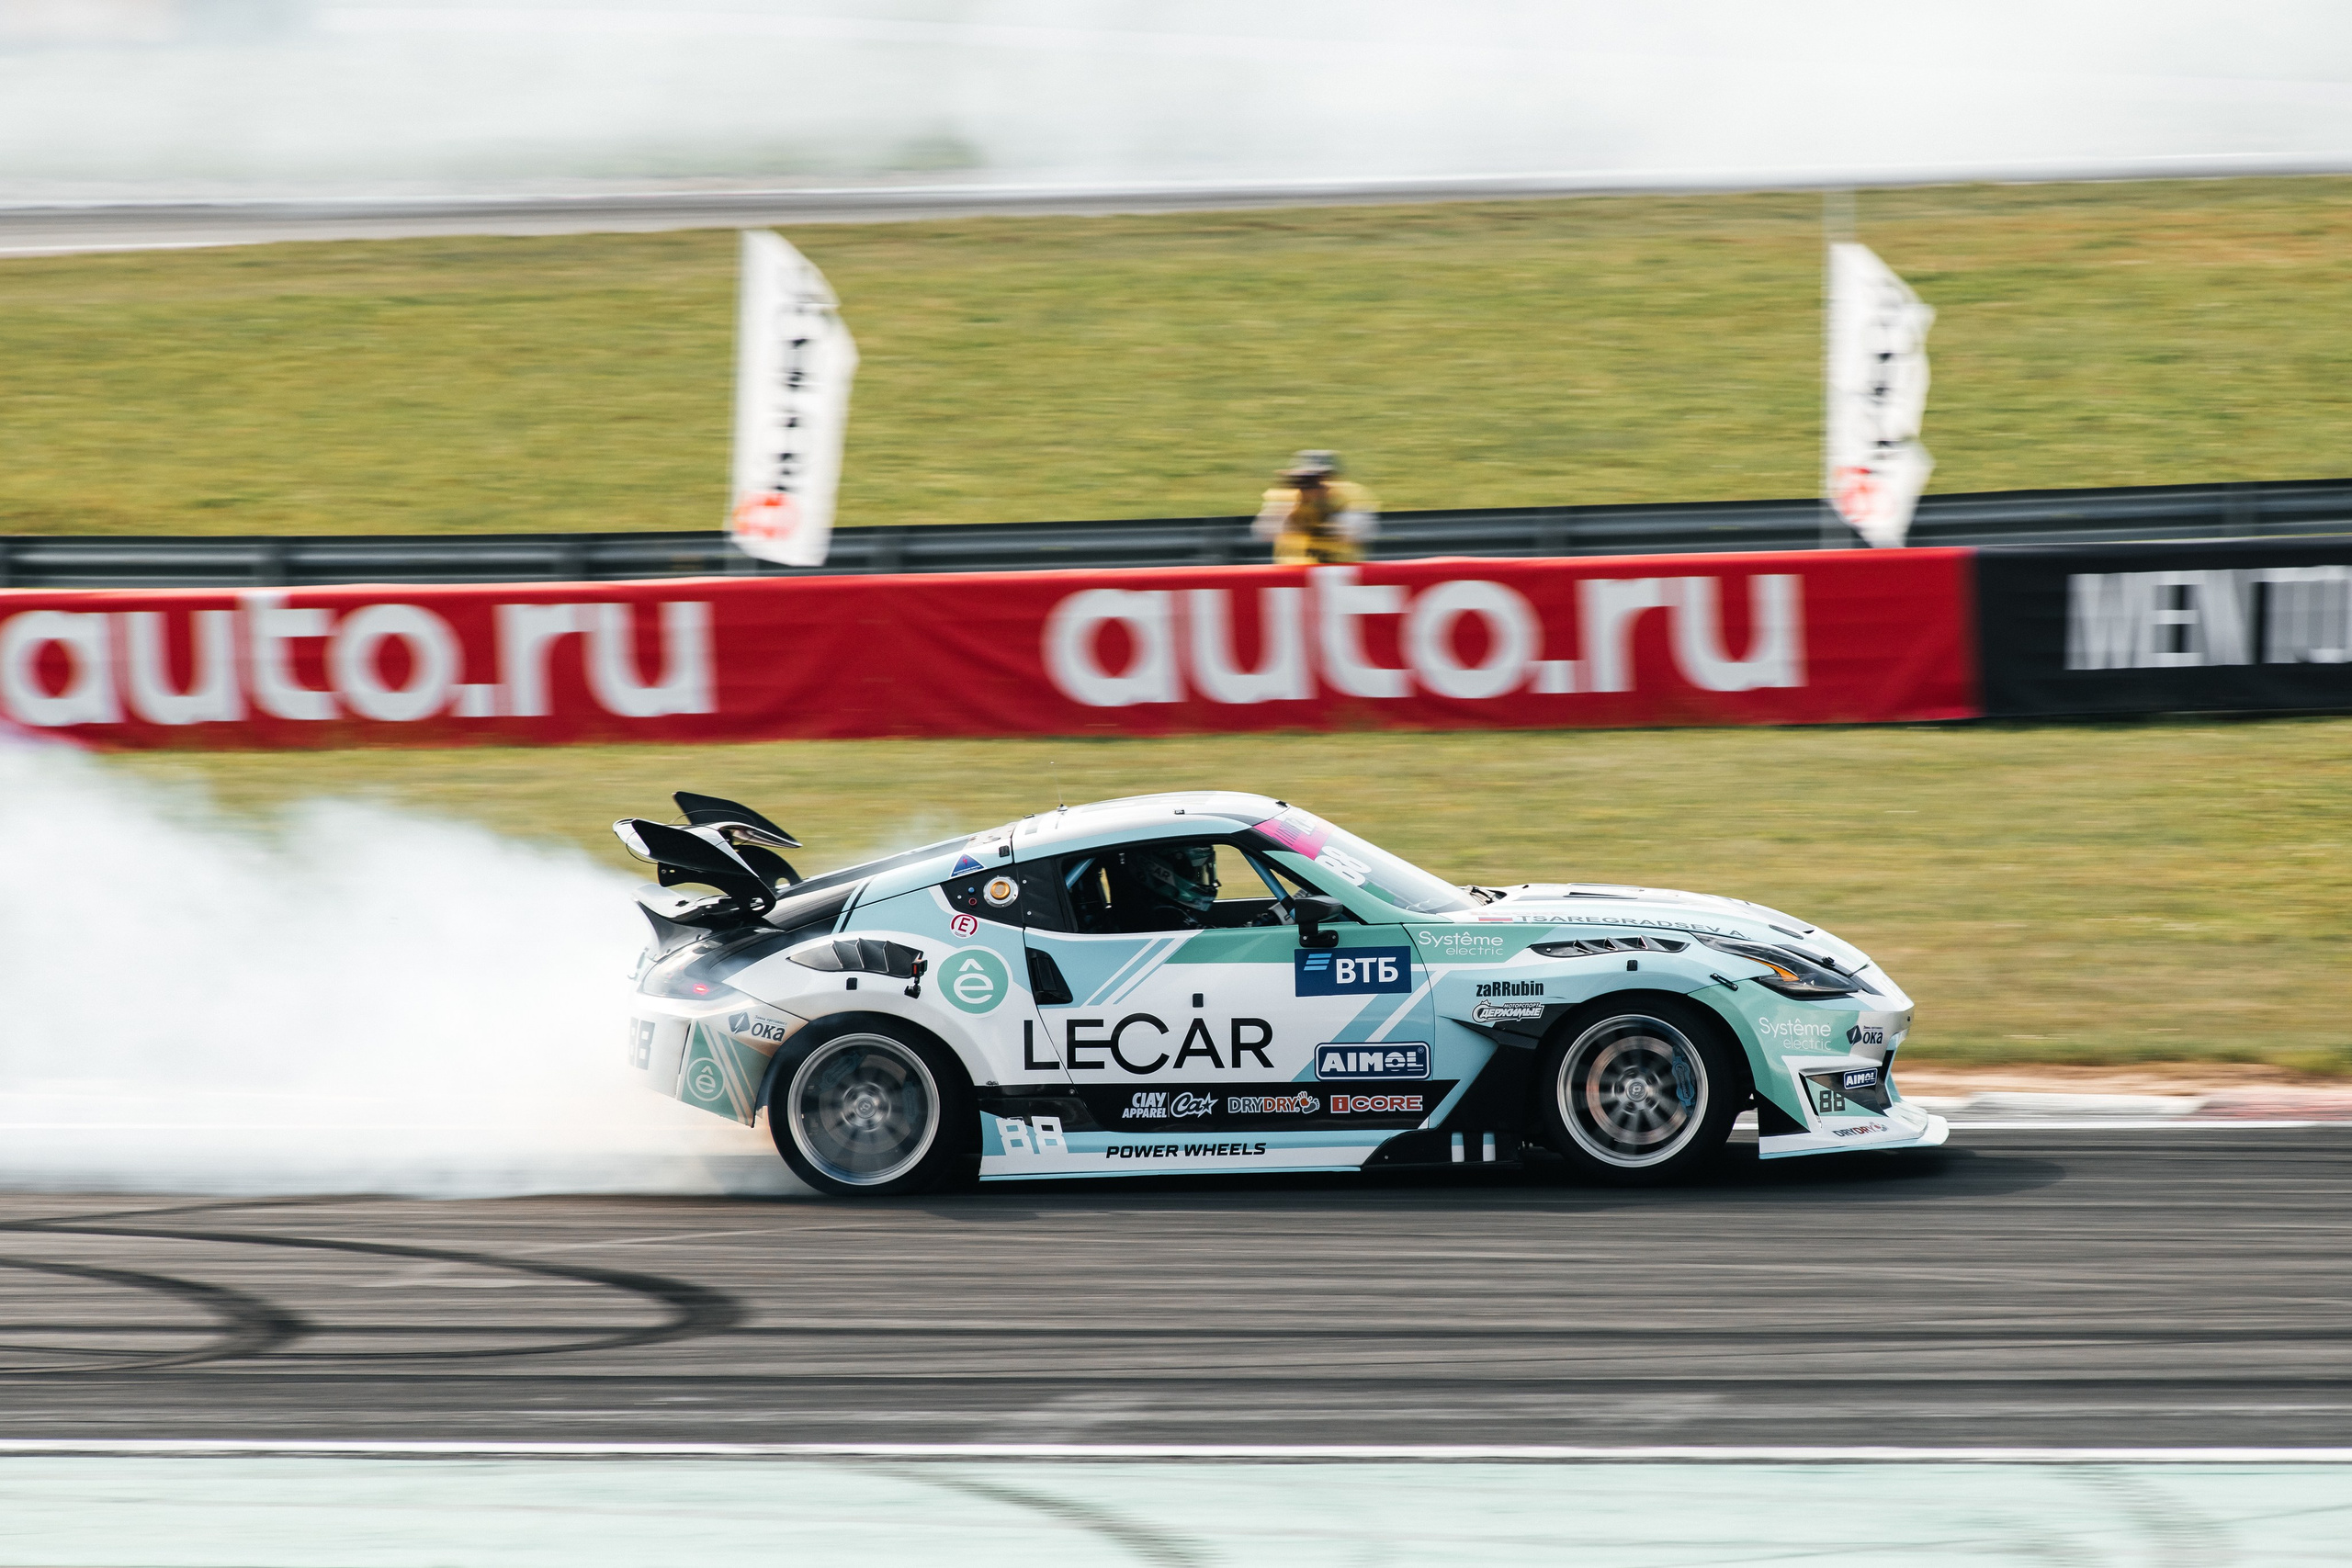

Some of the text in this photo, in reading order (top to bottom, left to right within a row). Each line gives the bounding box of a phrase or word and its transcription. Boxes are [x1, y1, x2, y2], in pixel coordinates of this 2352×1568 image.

[1039, 565, 1806, 707] auto.ru
[0, 589, 718, 727] auto.ru
[1314, 845, 1373, 887] 88
[1515, 915, 1722, 932] TSAREGRADSEV
[1418, 931, 1504, 948] Systême
[1445, 946, 1504, 956] electric
[1336, 957, 1399, 985] ВТБ
[1476, 981, 1544, 997] zaRRubin
[1758, 1017, 1832, 1038] Systême
[1023, 1012, 1275, 1076] LECAR
[1783, 1038, 1832, 1050] electric
[1846, 1073, 1876, 1087] AIMOL
[1820, 1090, 1846, 1112] 88
[1122, 1108, 1167, 1118] APPAREL
[996, 1115, 1069, 1156] 88
[1106, 1143, 1267, 1158] POWER WHEELS
